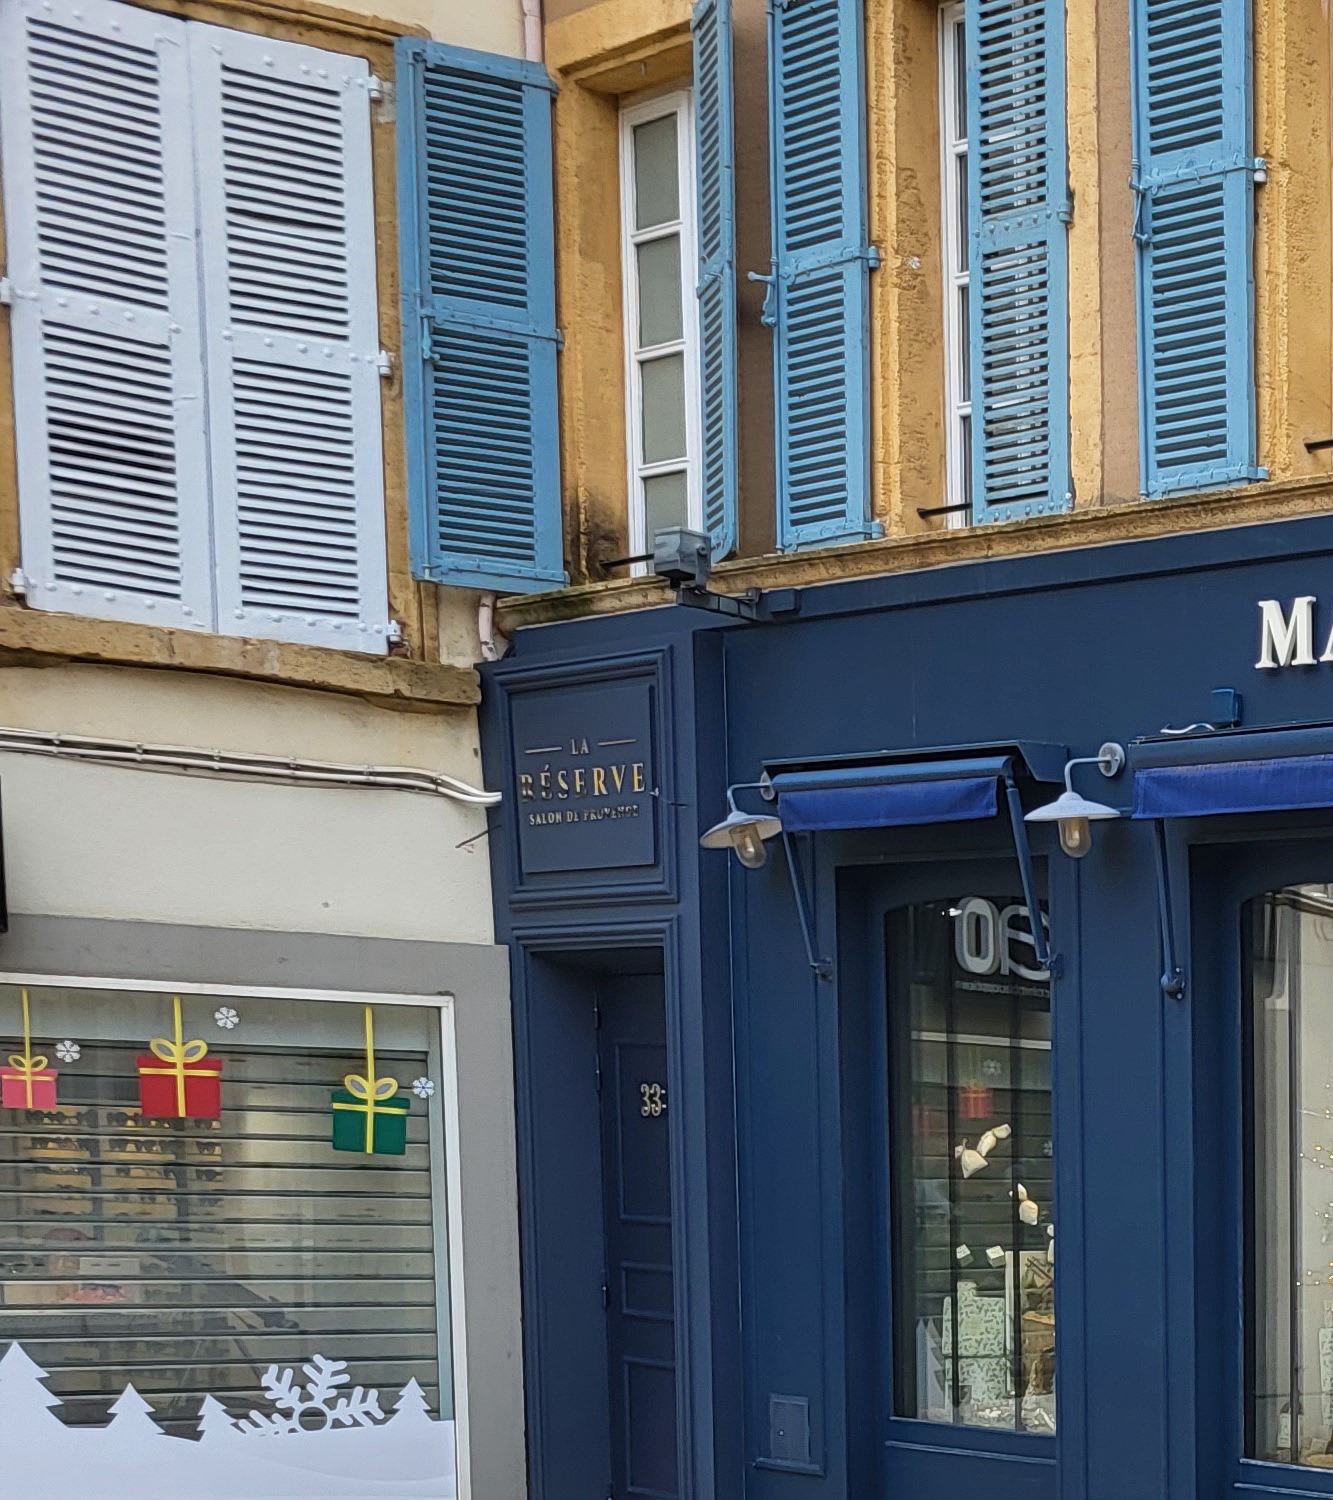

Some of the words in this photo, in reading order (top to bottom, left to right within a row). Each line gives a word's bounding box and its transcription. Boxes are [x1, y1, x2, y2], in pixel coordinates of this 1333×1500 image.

[570, 738, 590, 755] LA
[519, 762, 645, 801] RÉSERVE
[529, 810, 562, 826] SALON
[640, 1083, 662, 1117] 33
